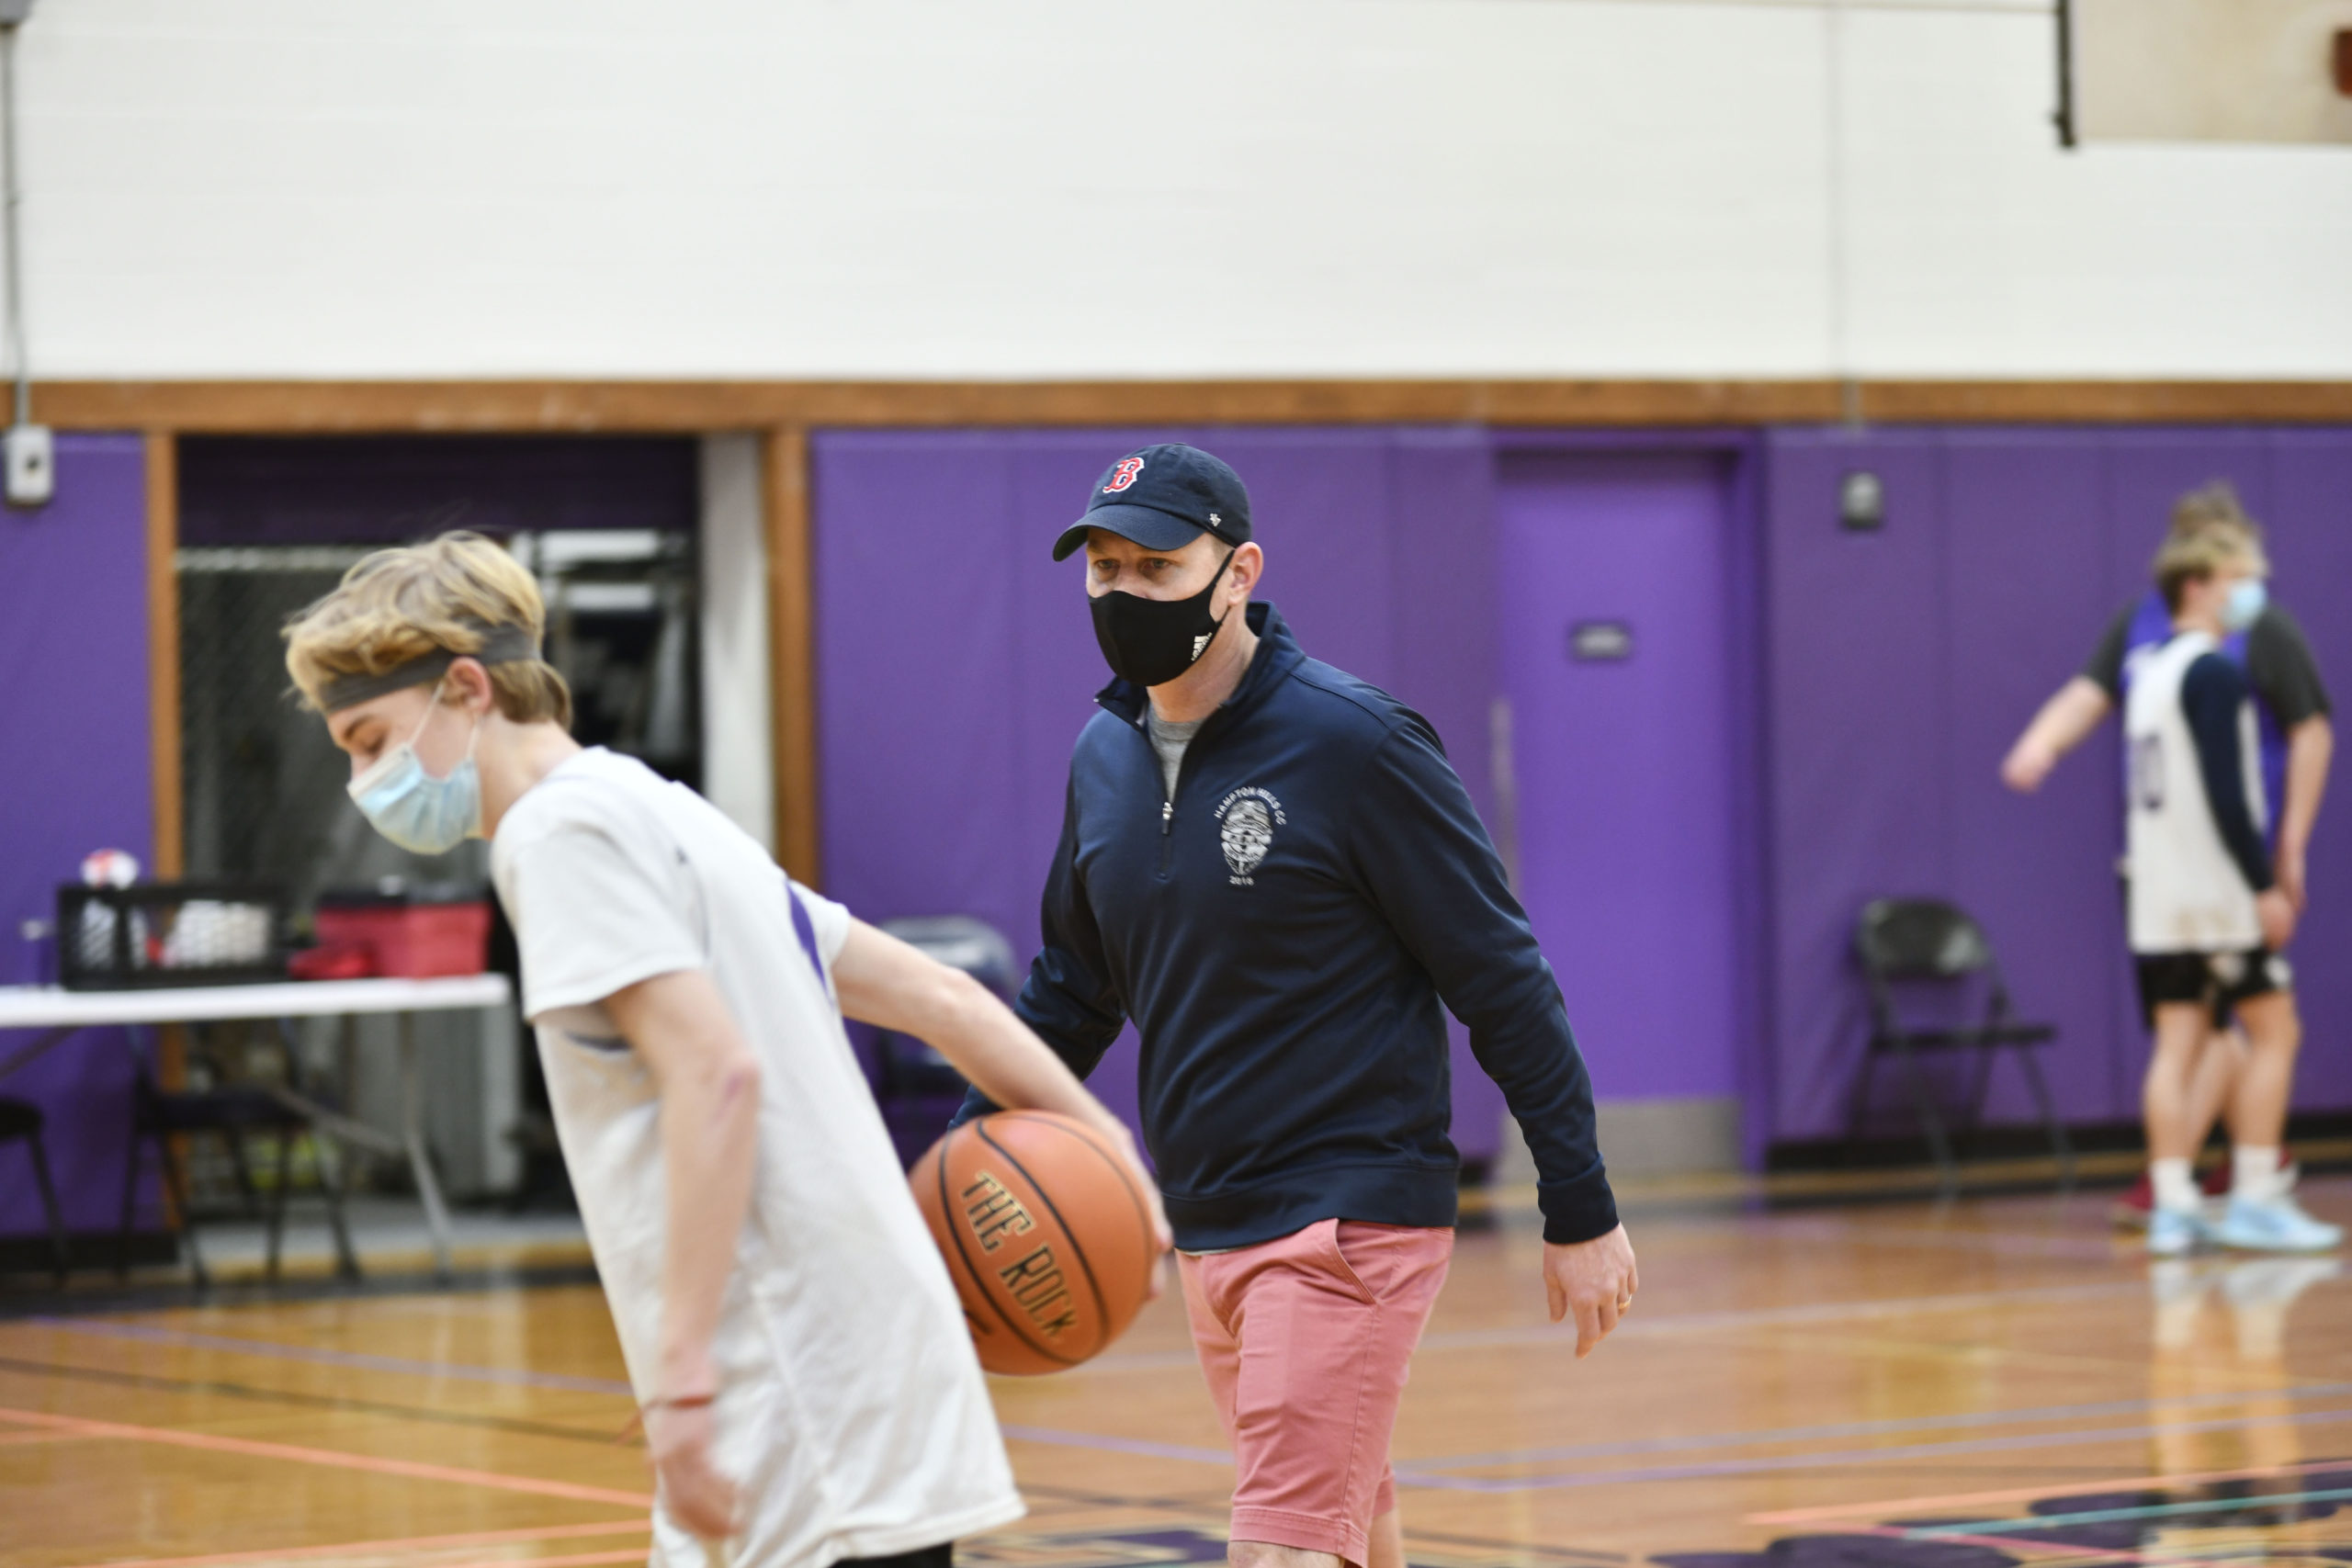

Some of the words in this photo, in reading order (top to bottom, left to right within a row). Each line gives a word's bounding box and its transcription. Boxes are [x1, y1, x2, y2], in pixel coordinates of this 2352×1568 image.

[1103, 457, 1145, 493] B
[1214, 786, 1257, 819] HAMPTON
[960, 1170, 1037, 1256] THE
[999, 1242, 1079, 1342] ROCK
